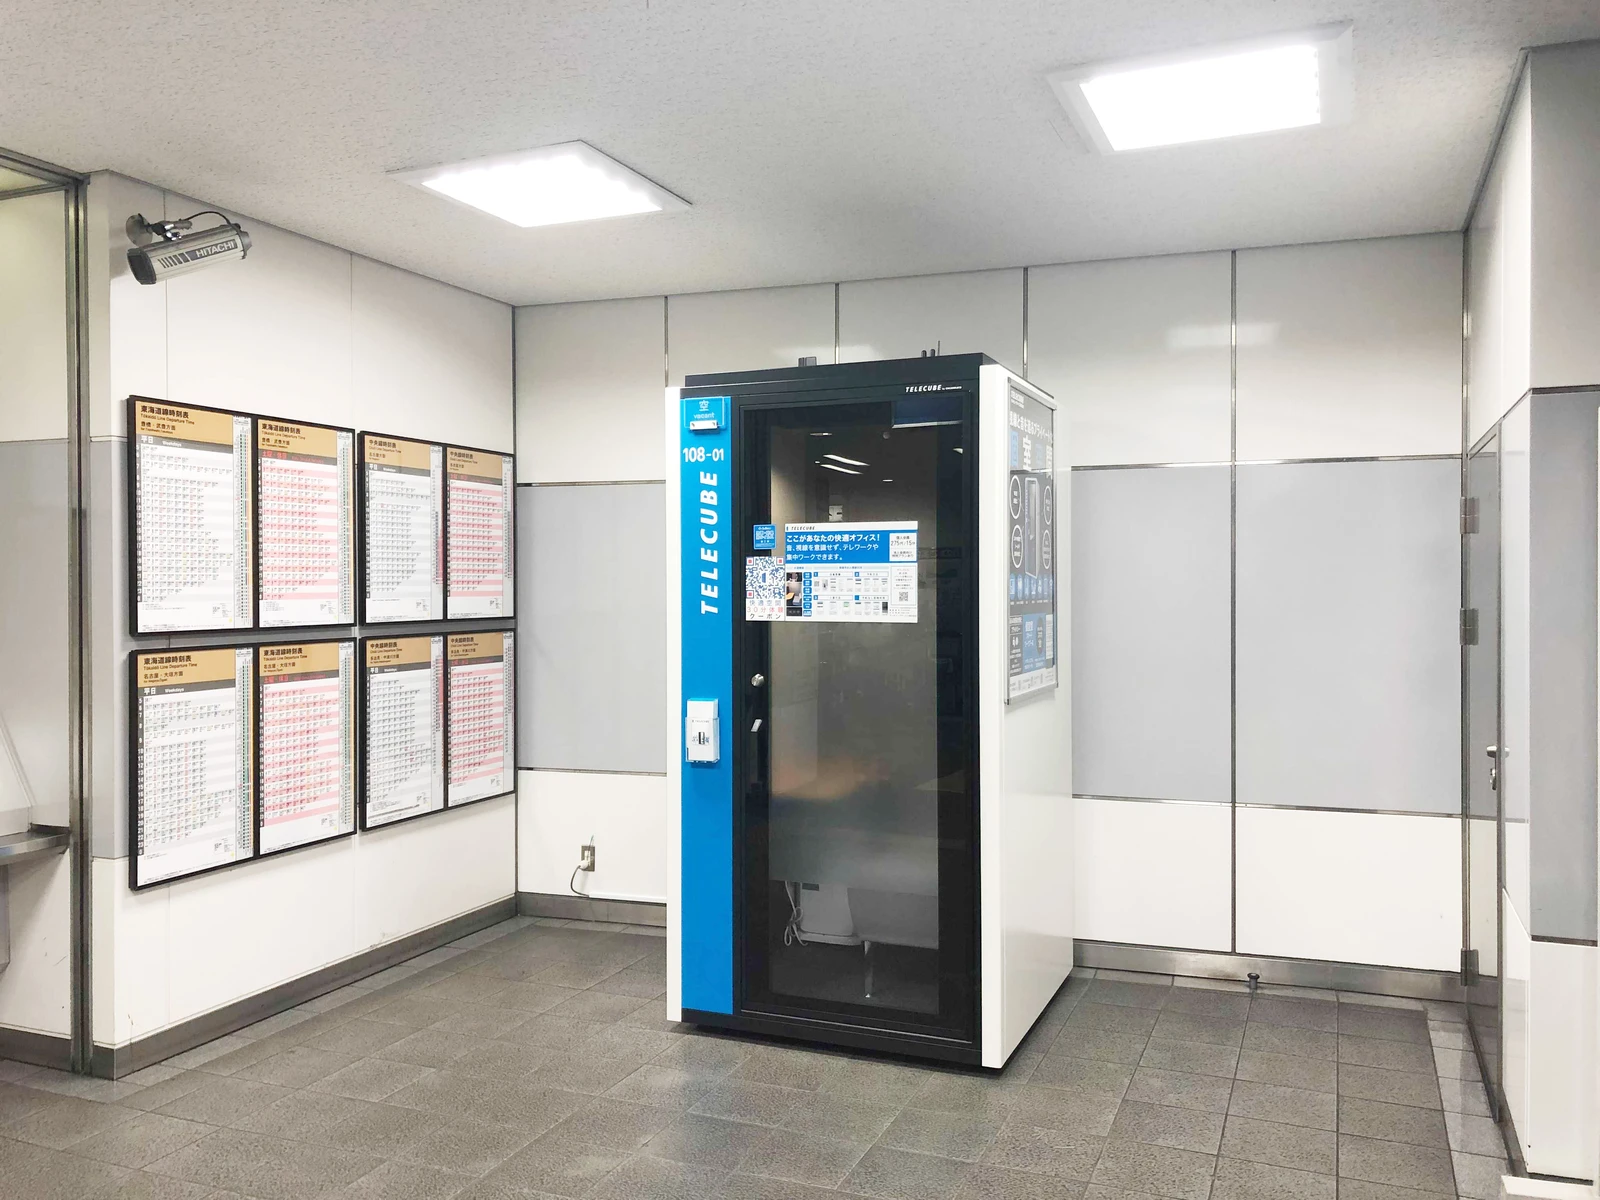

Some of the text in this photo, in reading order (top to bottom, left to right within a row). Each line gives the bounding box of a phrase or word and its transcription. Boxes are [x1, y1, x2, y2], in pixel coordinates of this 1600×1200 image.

[196, 241, 235, 258] HITACHI
[905, 384, 942, 393] TELECUBE
[699, 400, 710, 411] 空
[140, 405, 189, 419] 東海道線時刻表
[693, 412, 715, 420] vacant
[261, 423, 301, 435] 東海道線時刻表
[140, 435, 154, 444] 平日
[682, 446, 725, 463] 108-01
[700, 471, 719, 614] TELECUBE
[263, 647, 303, 657] 東海道線時刻表
[143, 655, 192, 665] 東海道線時刻表
[143, 687, 156, 695] 平日
